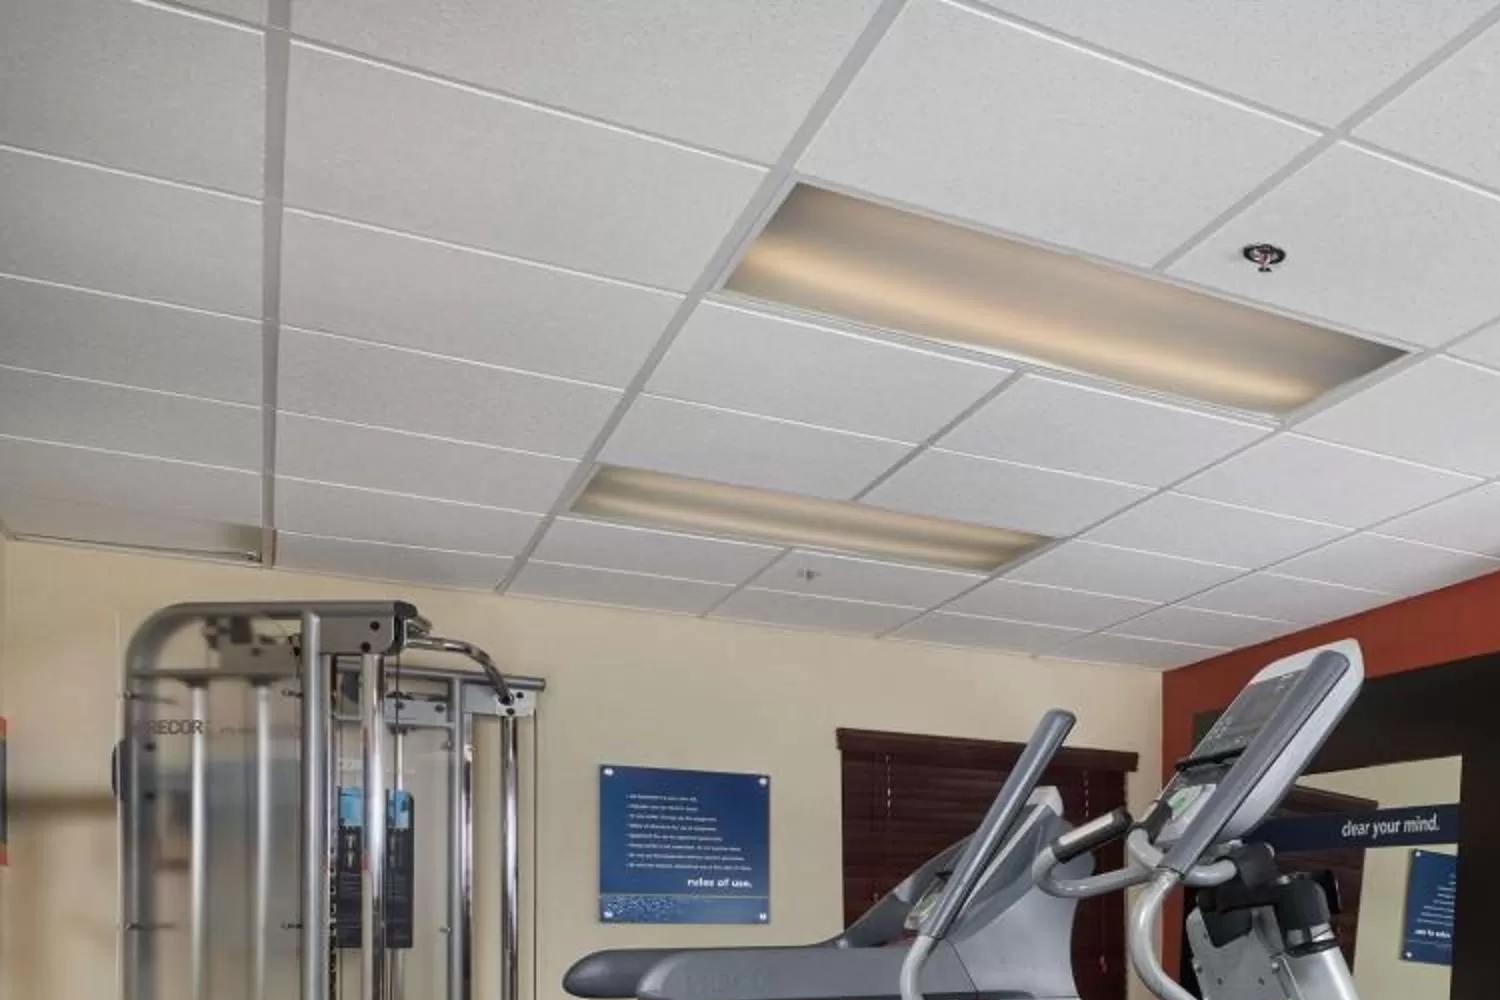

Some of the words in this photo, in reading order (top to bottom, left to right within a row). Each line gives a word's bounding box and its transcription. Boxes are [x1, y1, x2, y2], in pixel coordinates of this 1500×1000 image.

[137, 719, 204, 735] RECOR
[1341, 820, 1370, 838] clear
[1372, 820, 1401, 839] your
[1403, 812, 1440, 833] mind.
[687, 876, 714, 888] rules
[717, 877, 730, 888] of
[731, 879, 753, 889] use.
